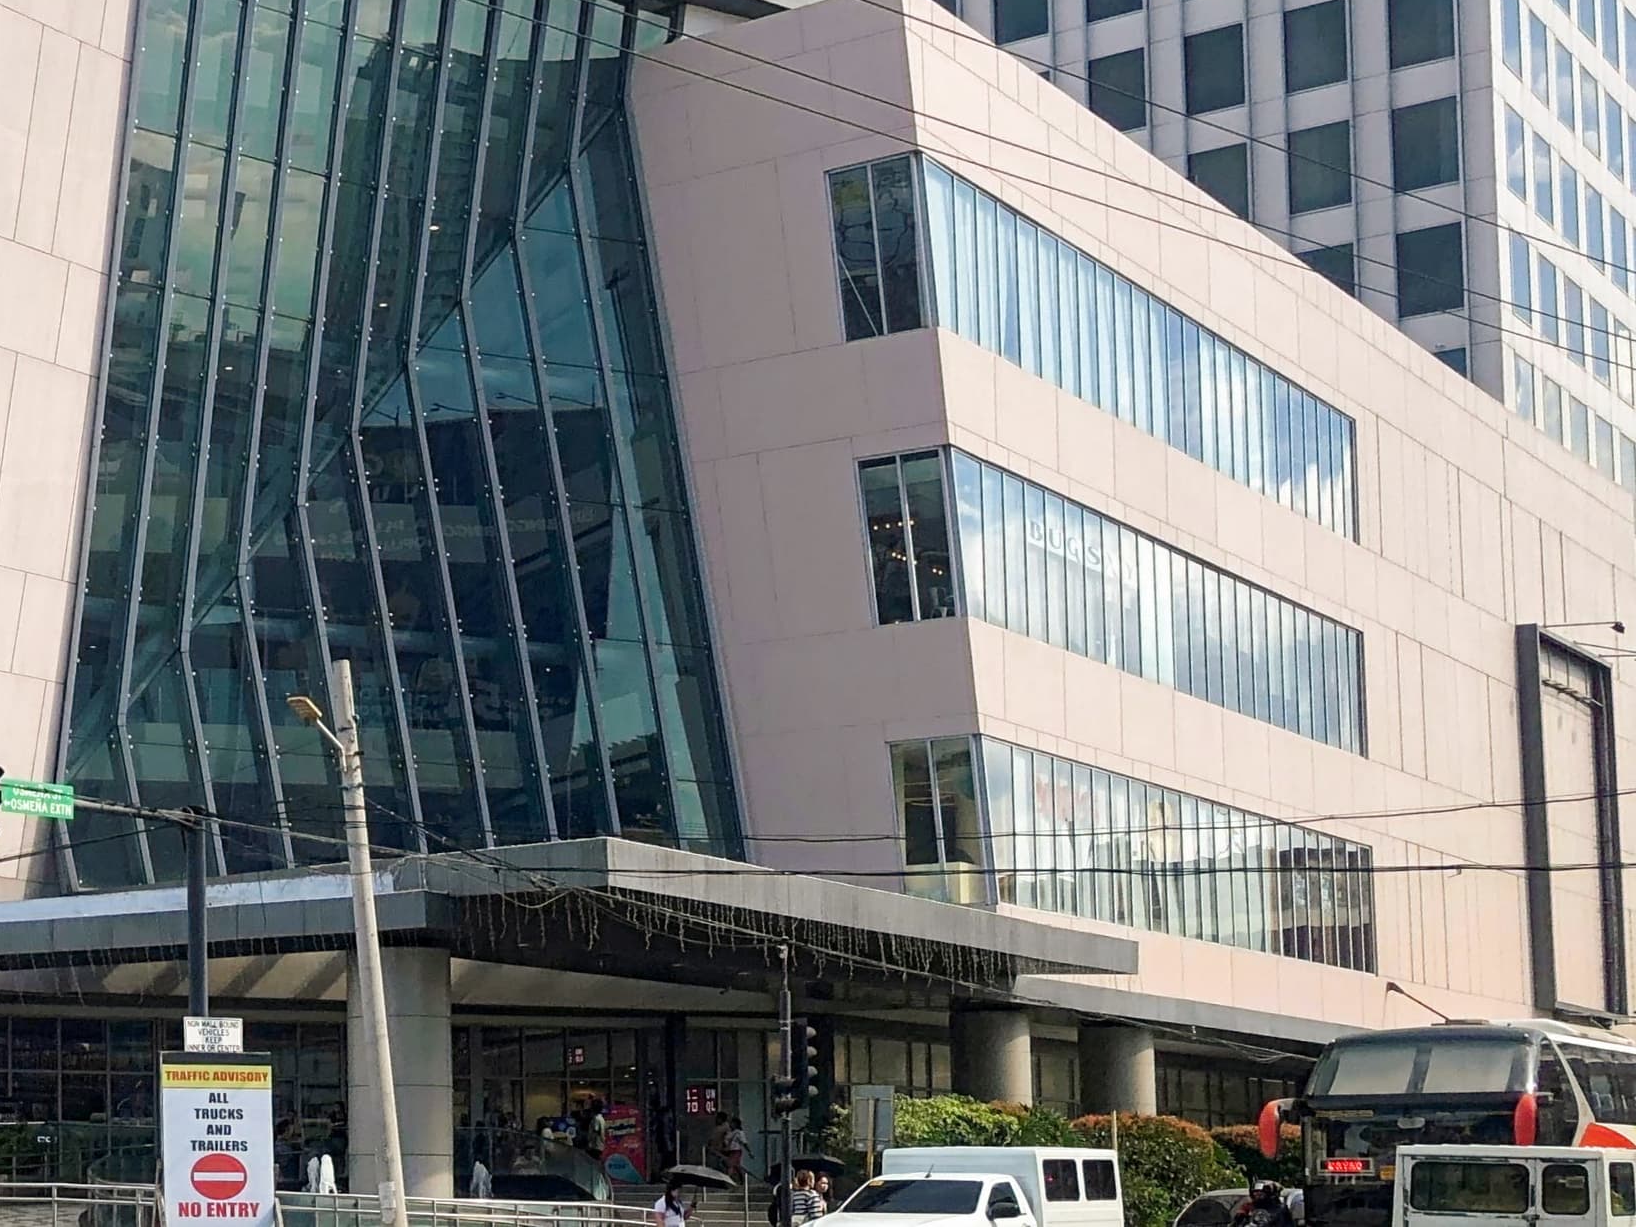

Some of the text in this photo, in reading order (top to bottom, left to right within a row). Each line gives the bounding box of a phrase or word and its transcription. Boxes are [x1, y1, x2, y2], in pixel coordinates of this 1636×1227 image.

[11, 798, 72, 816] OSMEÑA EXTN
[197, 1028, 230, 1036] VEHICLES
[205, 1036, 222, 1044] KEEP
[165, 1070, 268, 1083] TRAFFIC ADVISORY
[208, 1092, 229, 1104] ALL
[194, 1108, 244, 1120] TRUCKS
[206, 1124, 232, 1136] AND
[190, 1140, 249, 1152] TRAILERS
[178, 1202, 261, 1218] NO ENTRY
